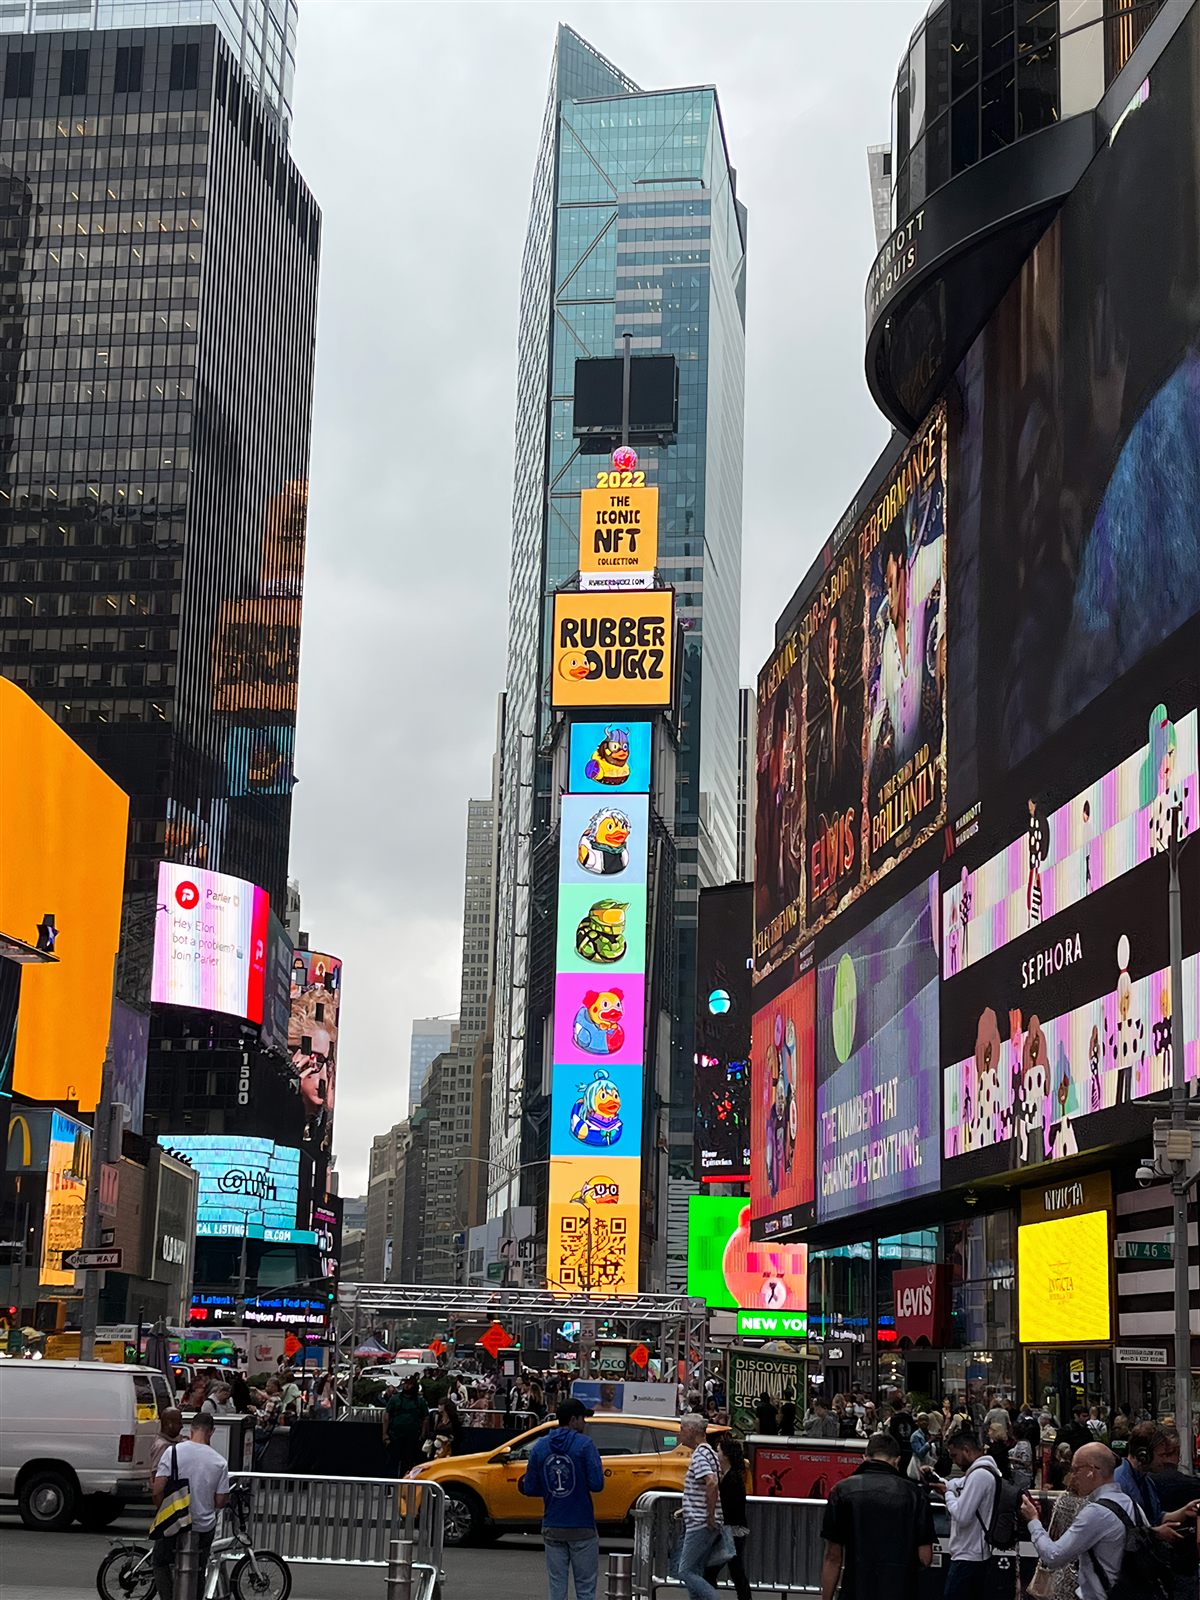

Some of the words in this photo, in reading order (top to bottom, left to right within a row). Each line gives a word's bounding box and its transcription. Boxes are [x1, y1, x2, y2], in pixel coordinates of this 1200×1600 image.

[596, 471, 646, 488] 2022
[610, 496, 630, 507] THE
[596, 510, 641, 525] ICONIC
[594, 528, 641, 554] NFT
[598, 558, 639, 566] COLLECTION
[560, 616, 665, 649] RUBBER
[584, 649, 664, 681] DUCKZ
[811, 807, 855, 902] ELVIS
[174, 917, 192, 931] Hey
[1021, 932, 1083, 989] SEPHORA
[238, 1052, 250, 1105] 1500
[822, 1106, 837, 1147] THE
[837, 1088, 874, 1139] NUMBER
[874, 1076, 898, 1126] THAT
[822, 1148, 859, 1196] CHANGED
[861, 1123, 922, 1184] EVERYTHING.
[1045, 1182, 1084, 1211] INVICTA
[70, 1255, 88, 1264] ONE
[96, 1253, 115, 1263] WAY
[1127, 1243, 1138, 1256] W
[1143, 1244, 1158, 1257] 46
[742, 1317, 777, 1330] NEW
[581, 1329, 594, 1337] 25
[736, 1359, 798, 1374] DISCOVER
